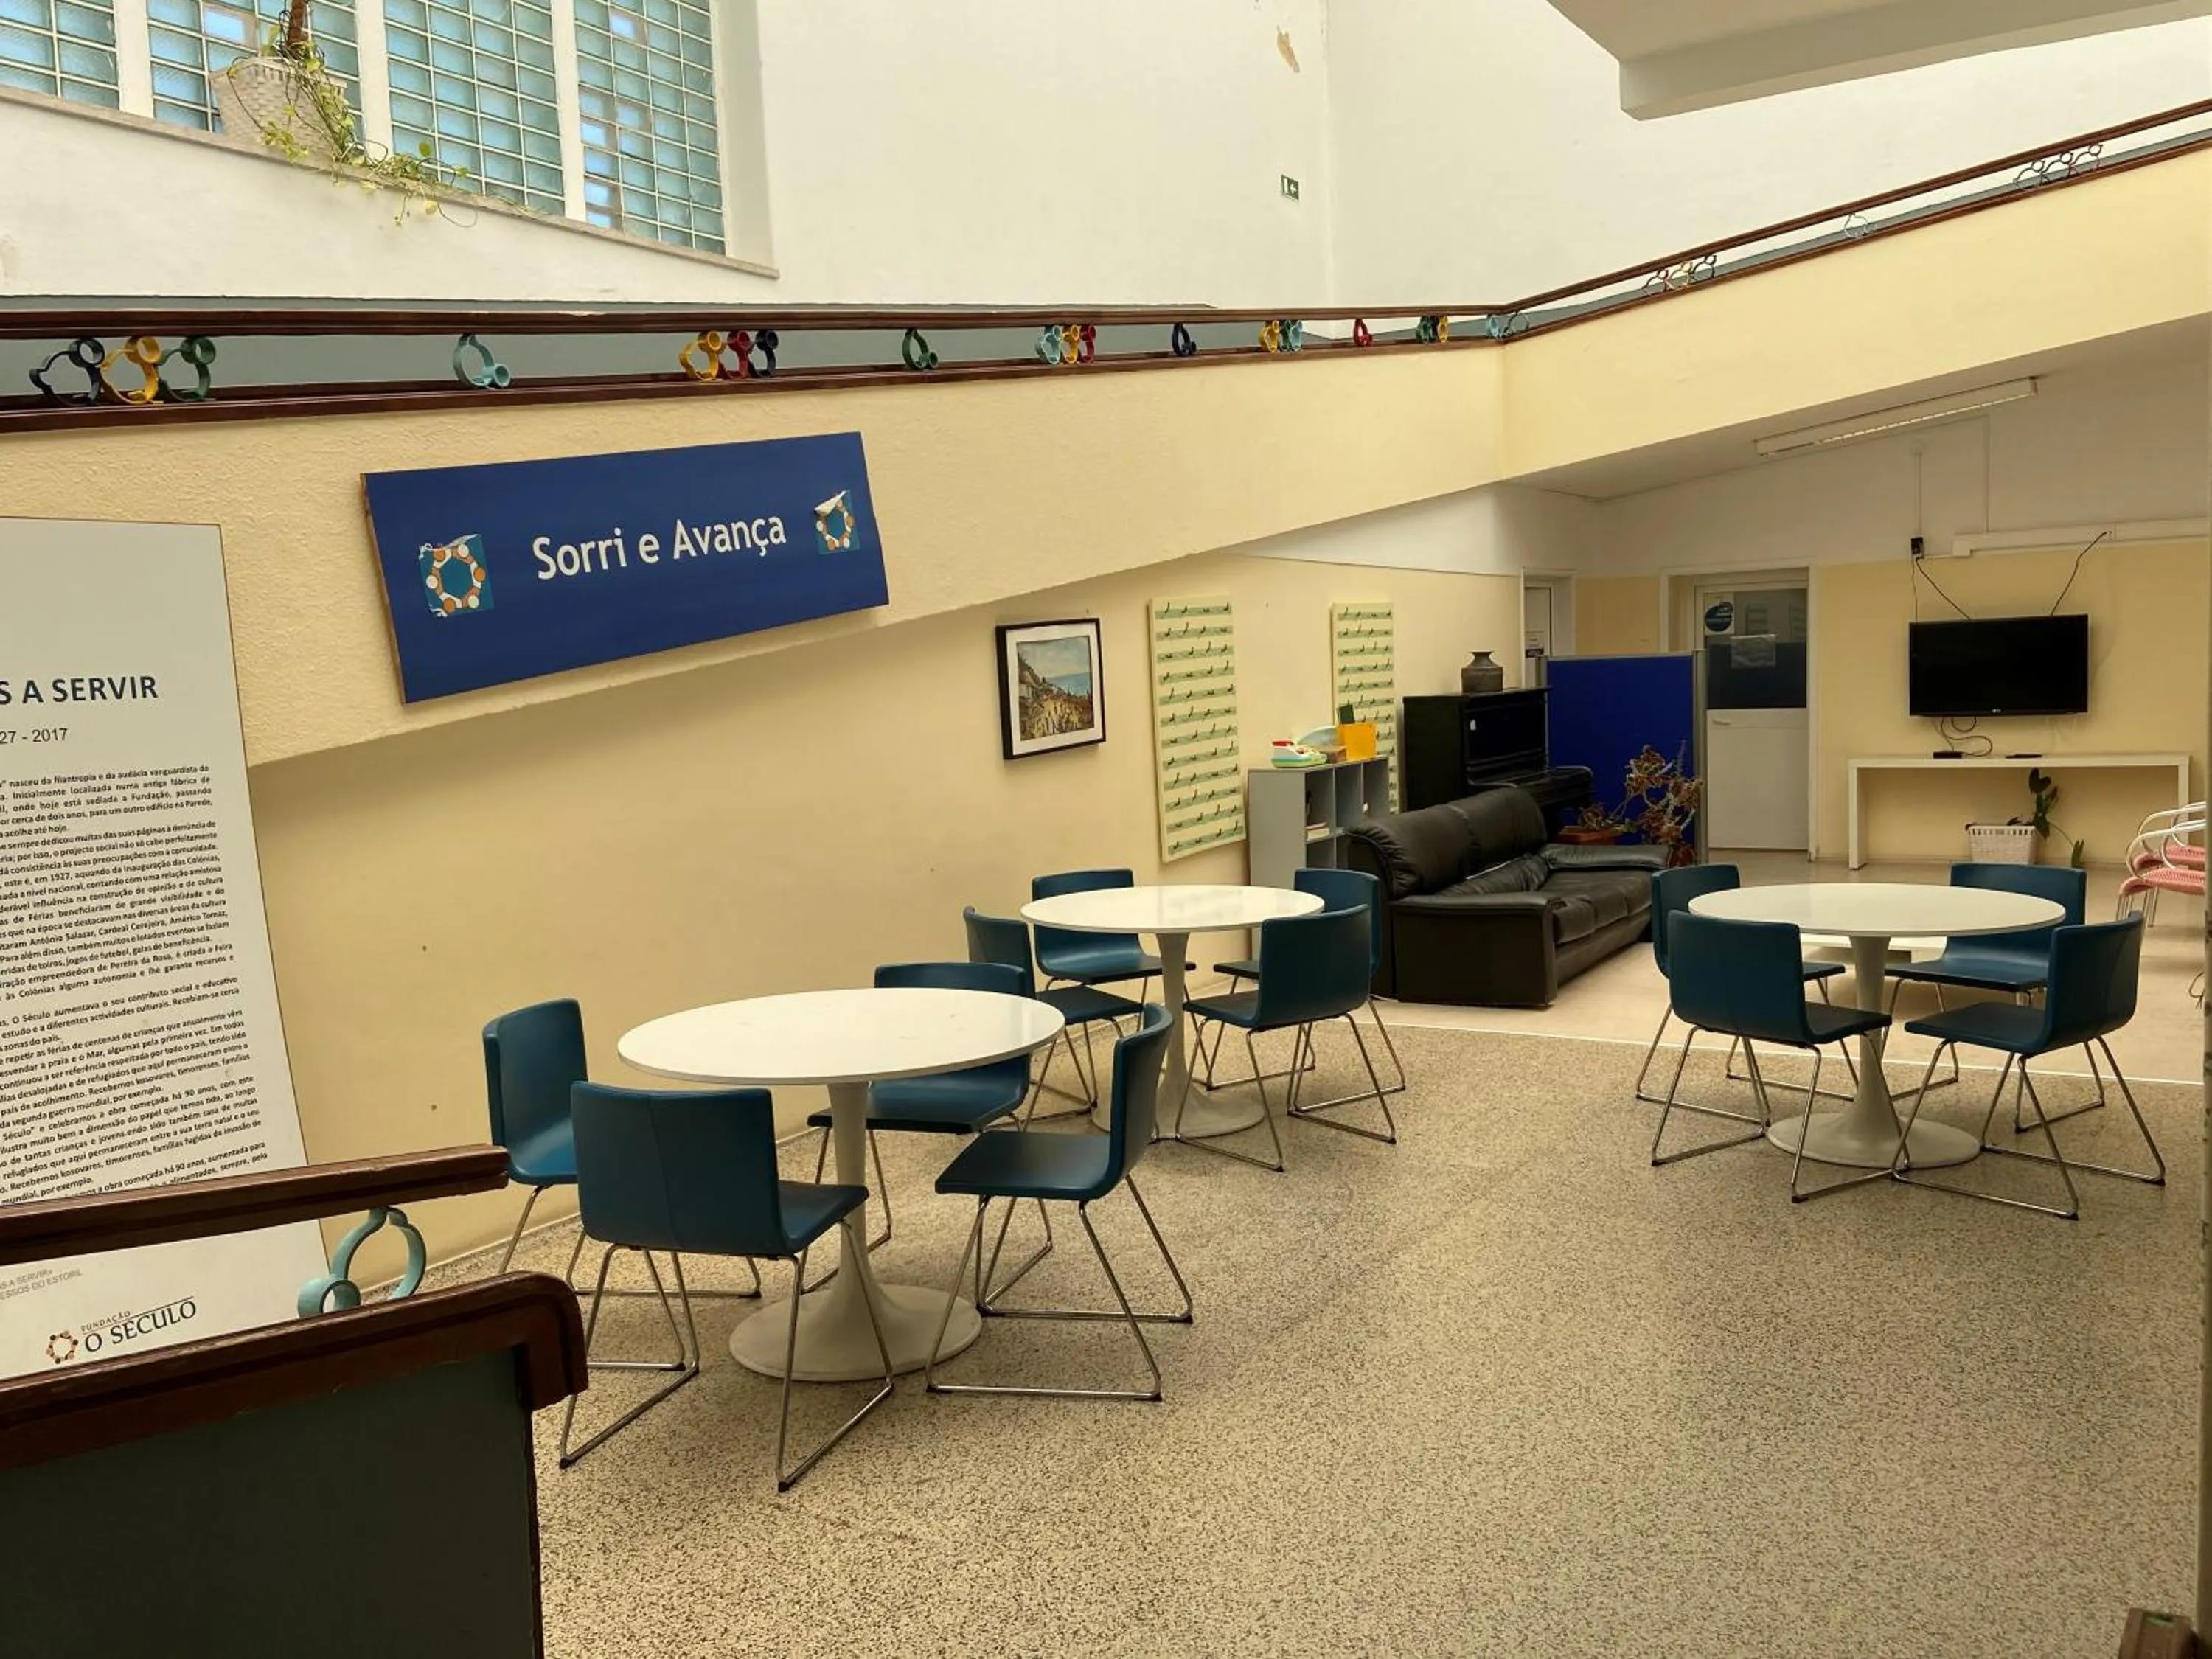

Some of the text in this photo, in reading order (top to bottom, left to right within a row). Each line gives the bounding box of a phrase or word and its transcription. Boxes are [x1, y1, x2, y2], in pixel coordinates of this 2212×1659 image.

[533, 516, 787, 580] Sorri e Avança
[22, 680, 44, 703] A
[52, 676, 158, 702] SERVIR
[32, 728, 68, 742] 2017
[80, 1310, 131, 1332] FUNDAÇÃO
[85, 1332, 102, 1352] O
